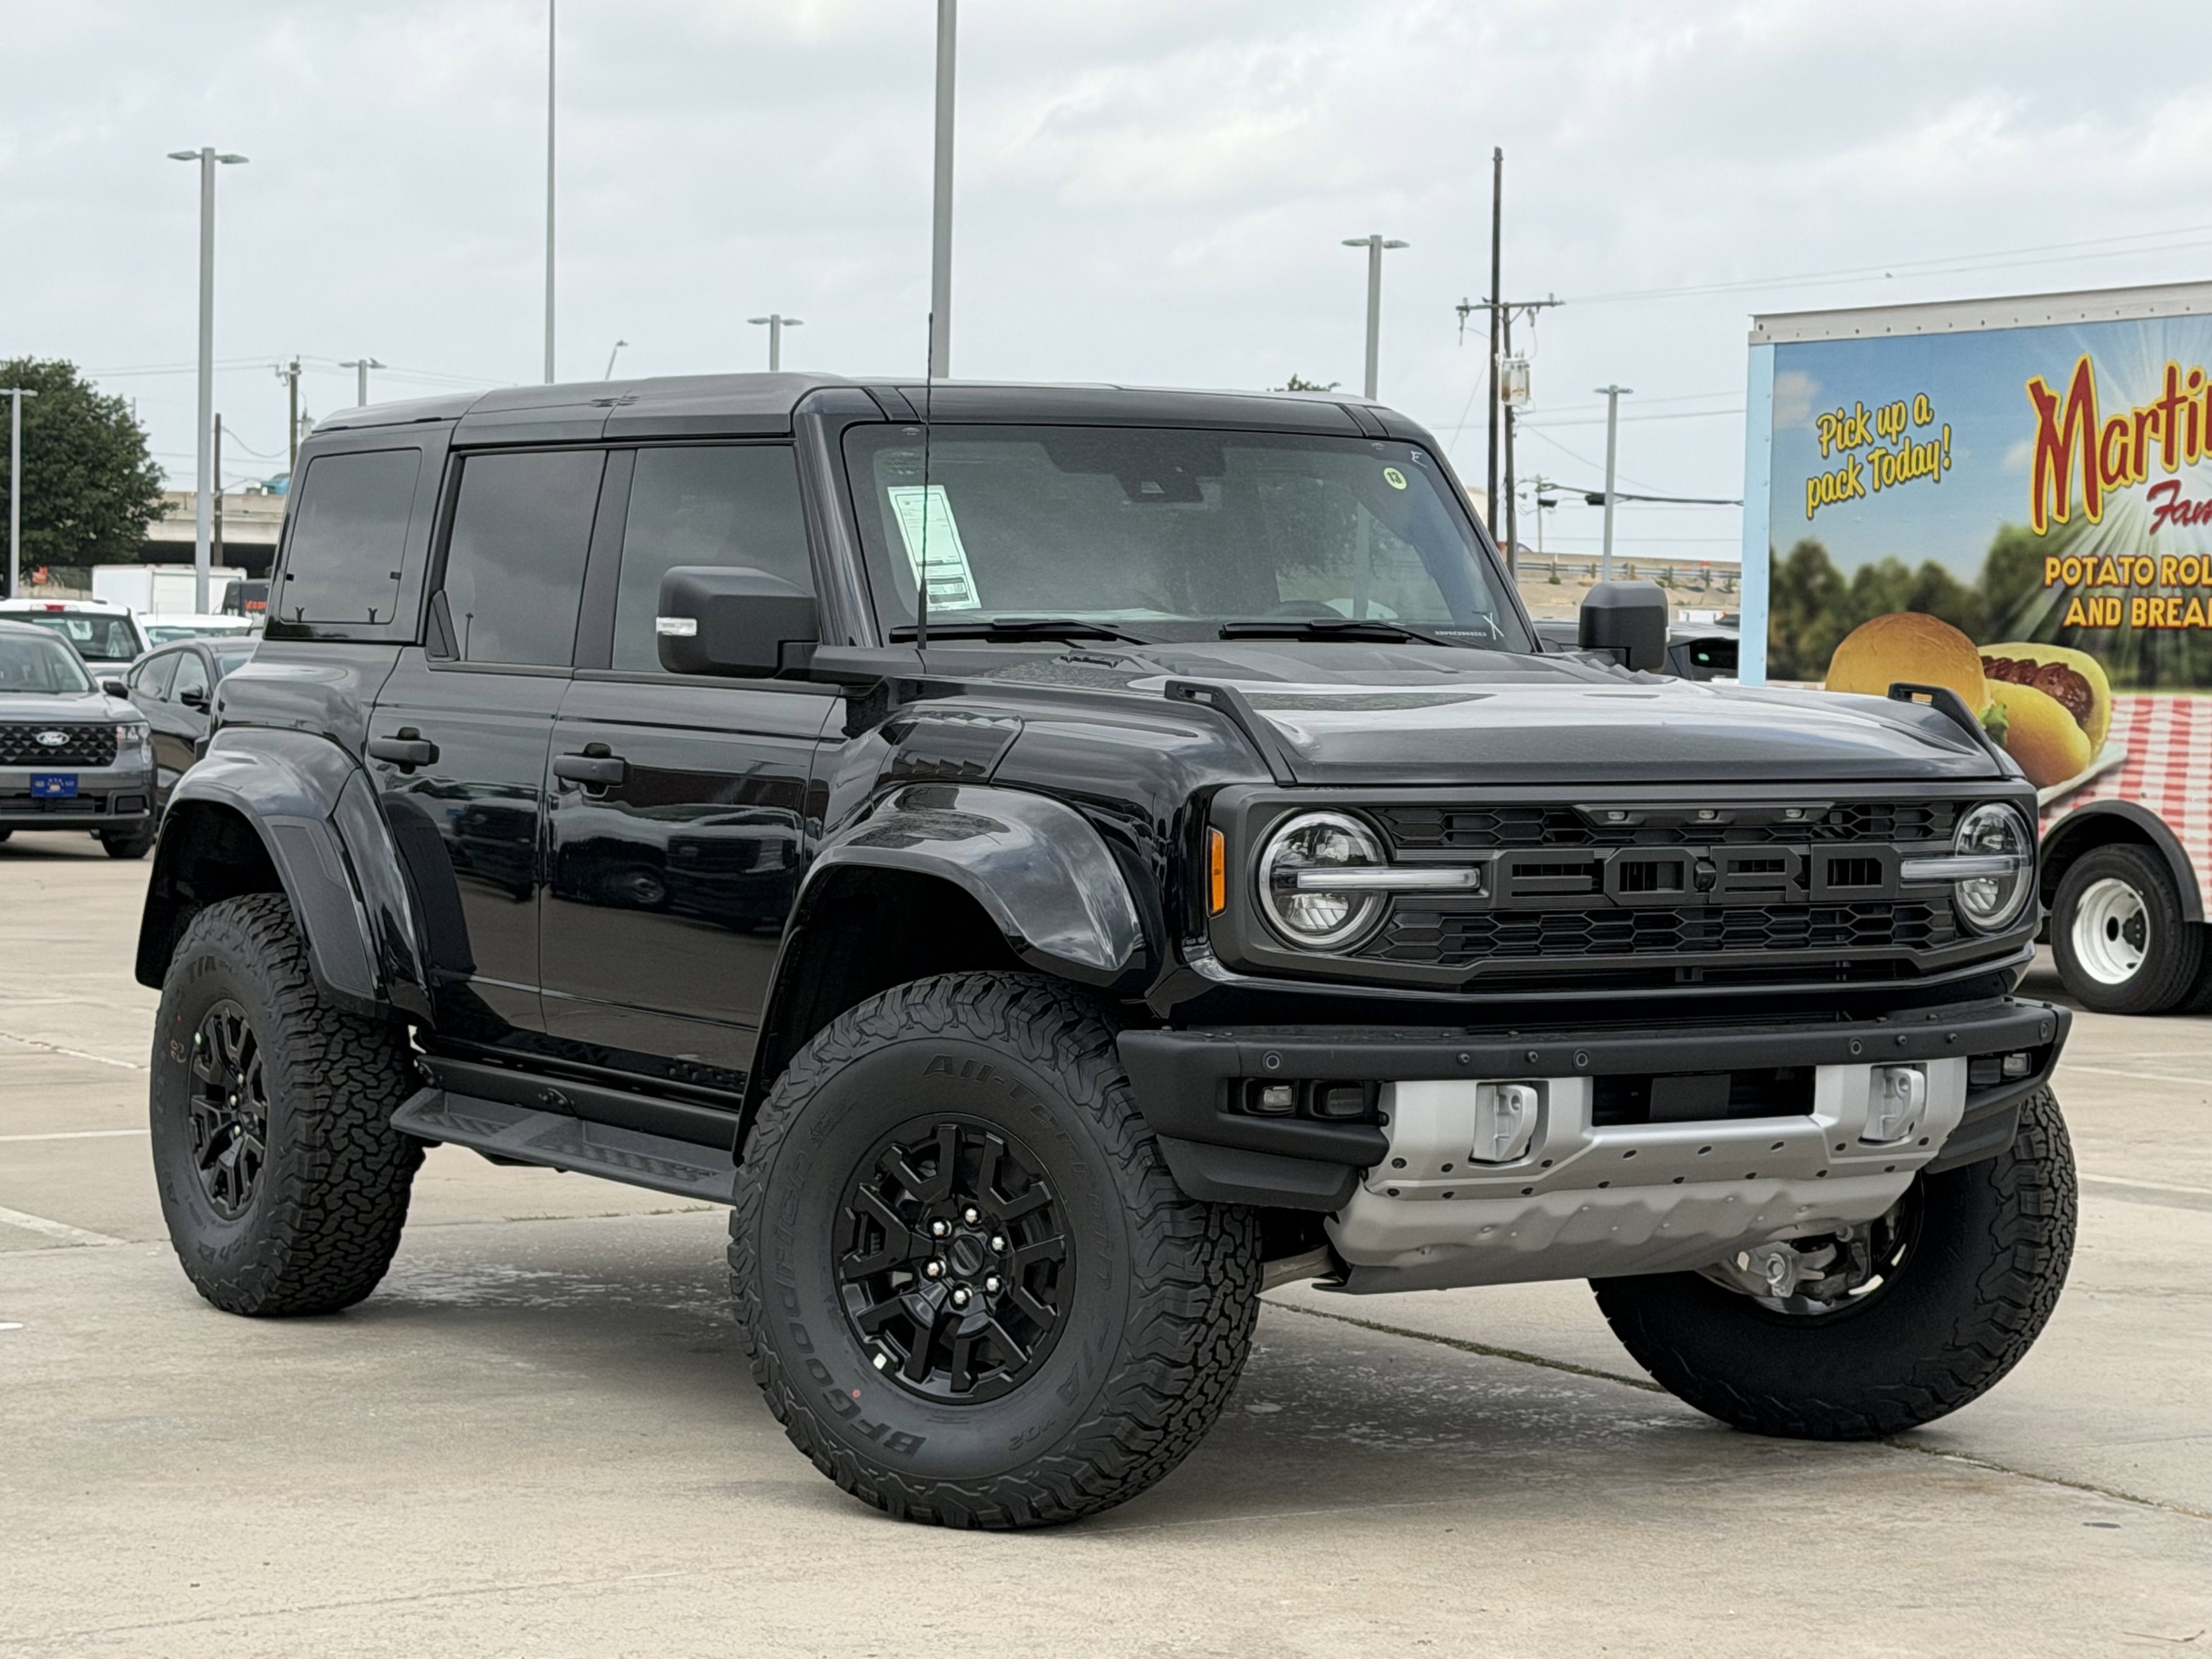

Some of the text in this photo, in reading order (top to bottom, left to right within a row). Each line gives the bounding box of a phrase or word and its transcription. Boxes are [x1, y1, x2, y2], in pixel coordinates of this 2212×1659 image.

[1816, 392, 1934, 459] Pick up a
[2026, 353, 2212, 535] Marti
[1386, 471, 1403, 484] 13
[1806, 423, 1951, 520] pack Today!
[2044, 555, 2157, 588] POTATO
[2063, 596, 2212, 629] AND BREA
[1491, 843, 1901, 908] FORD
